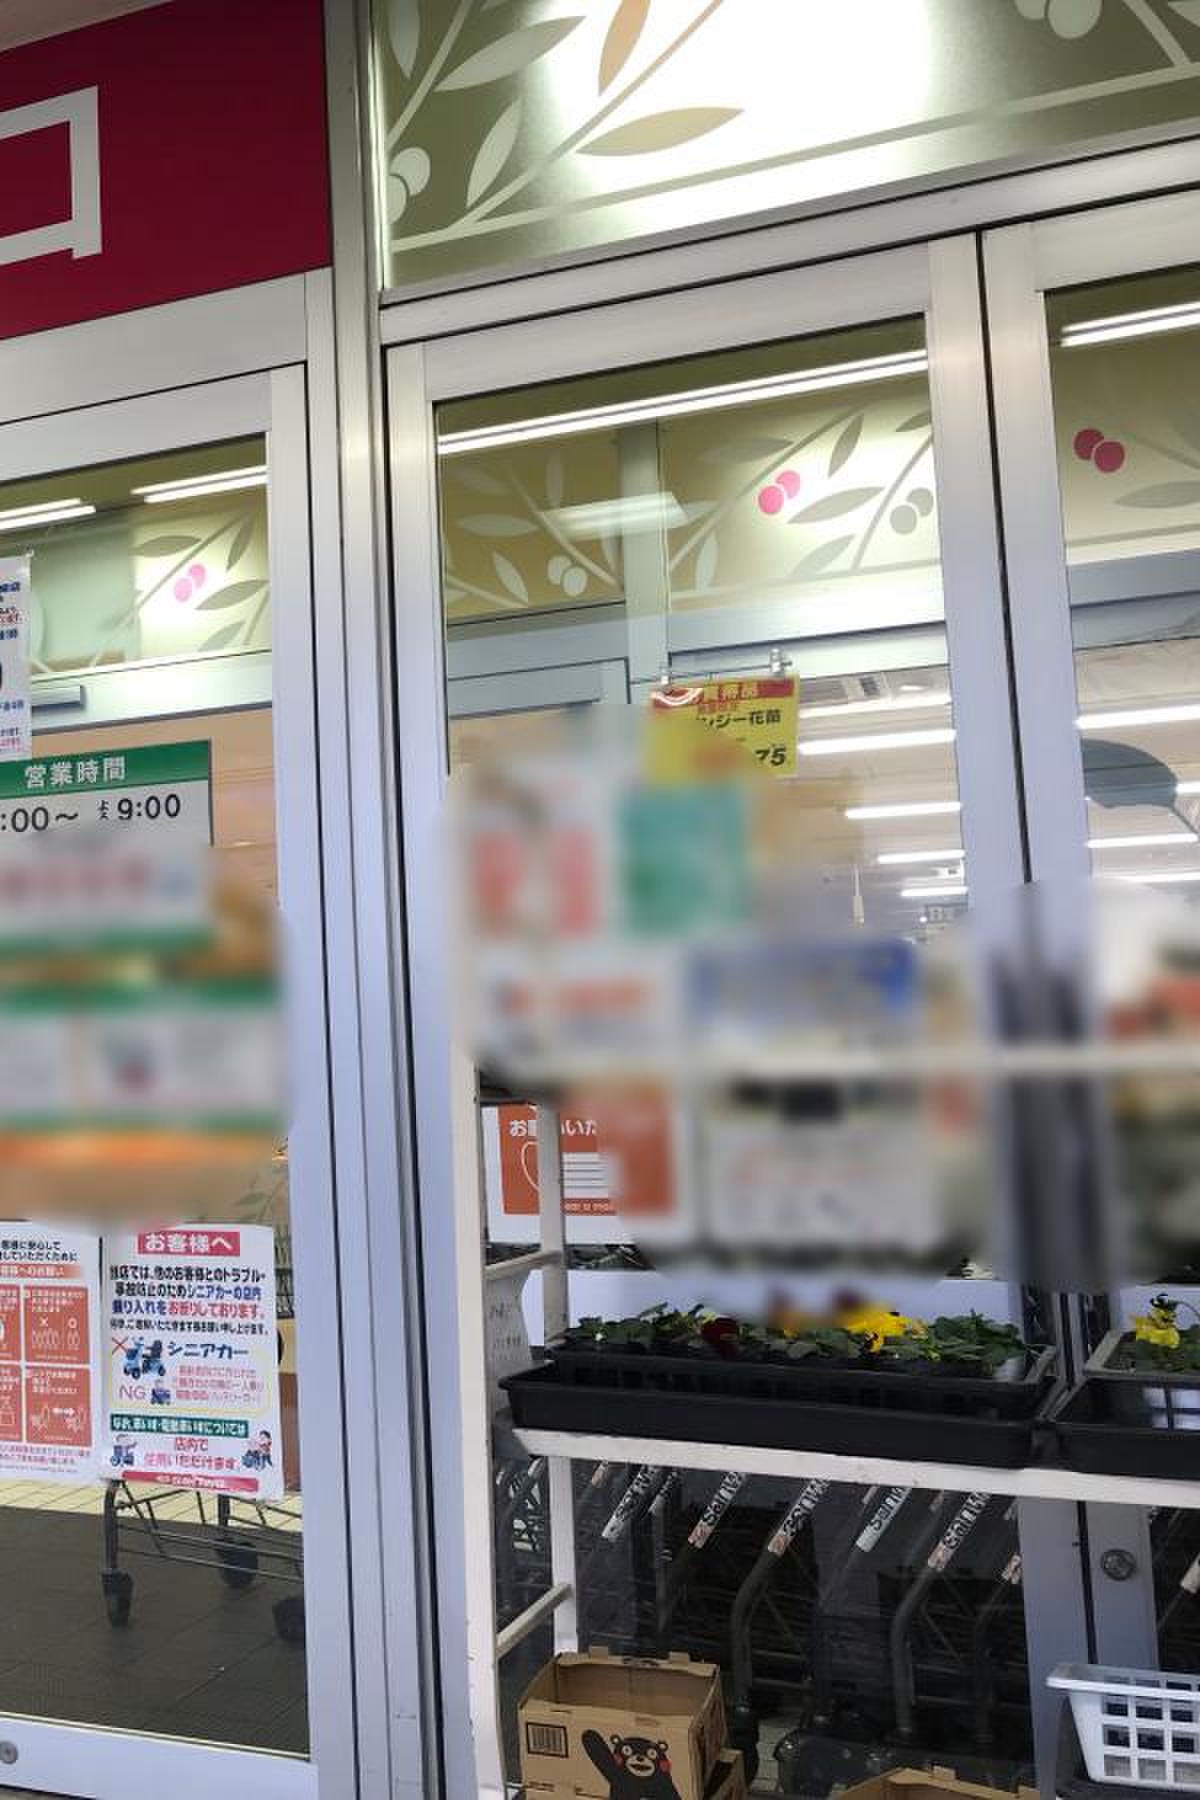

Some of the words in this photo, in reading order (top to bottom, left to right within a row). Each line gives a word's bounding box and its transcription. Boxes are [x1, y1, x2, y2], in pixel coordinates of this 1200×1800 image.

[24, 756, 126, 789] 営業時間
[117, 793, 182, 821] 9:00
[145, 1233, 233, 1254] お客様へ
[167, 1341, 249, 1361] シニアカー
[118, 1384, 146, 1400] NG
